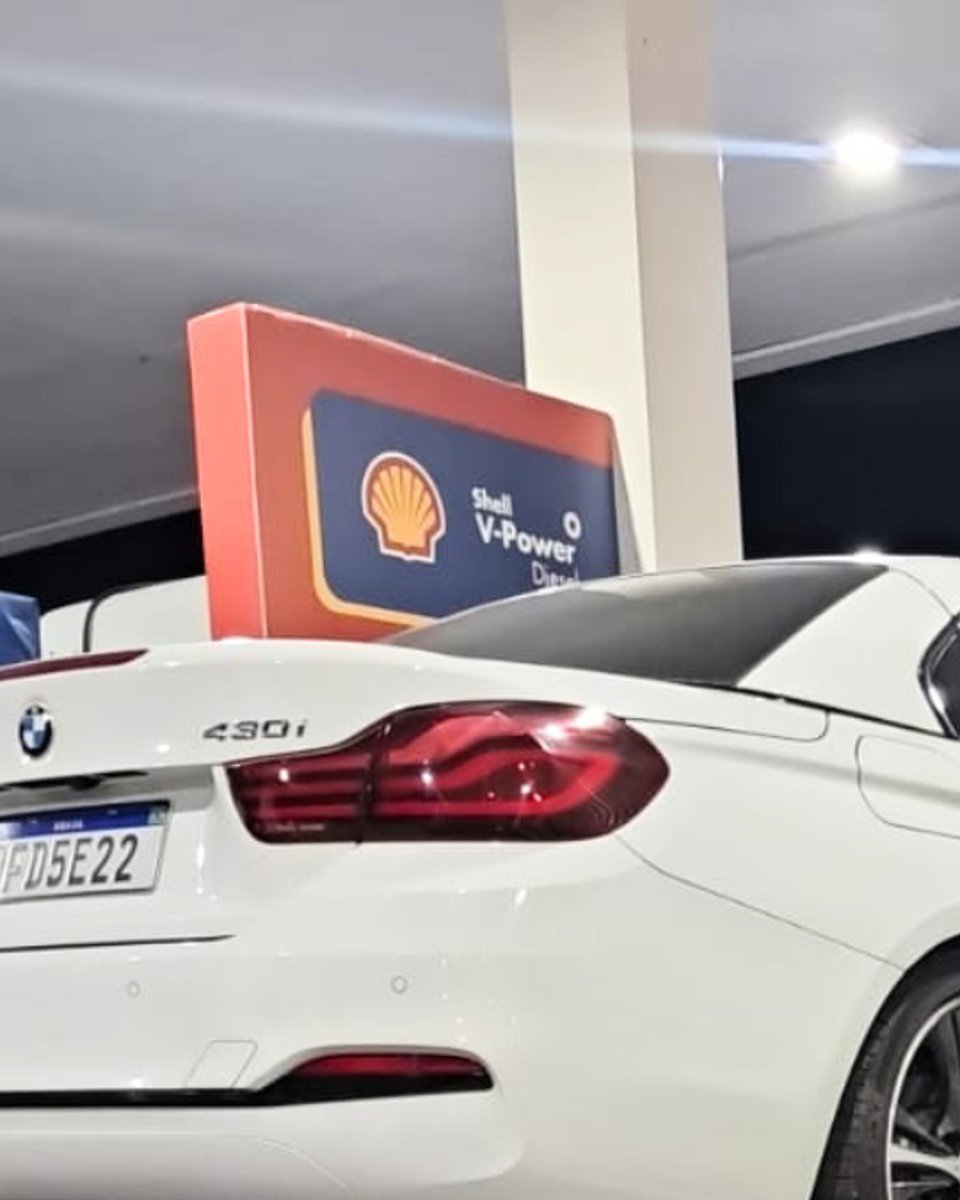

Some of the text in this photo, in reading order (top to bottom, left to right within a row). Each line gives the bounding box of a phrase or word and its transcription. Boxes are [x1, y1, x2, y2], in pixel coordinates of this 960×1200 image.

[471, 486, 513, 517] Shell
[475, 512, 577, 564] V-Power
[202, 719, 308, 741] 430i
[0, 833, 138, 893] FD5E22
